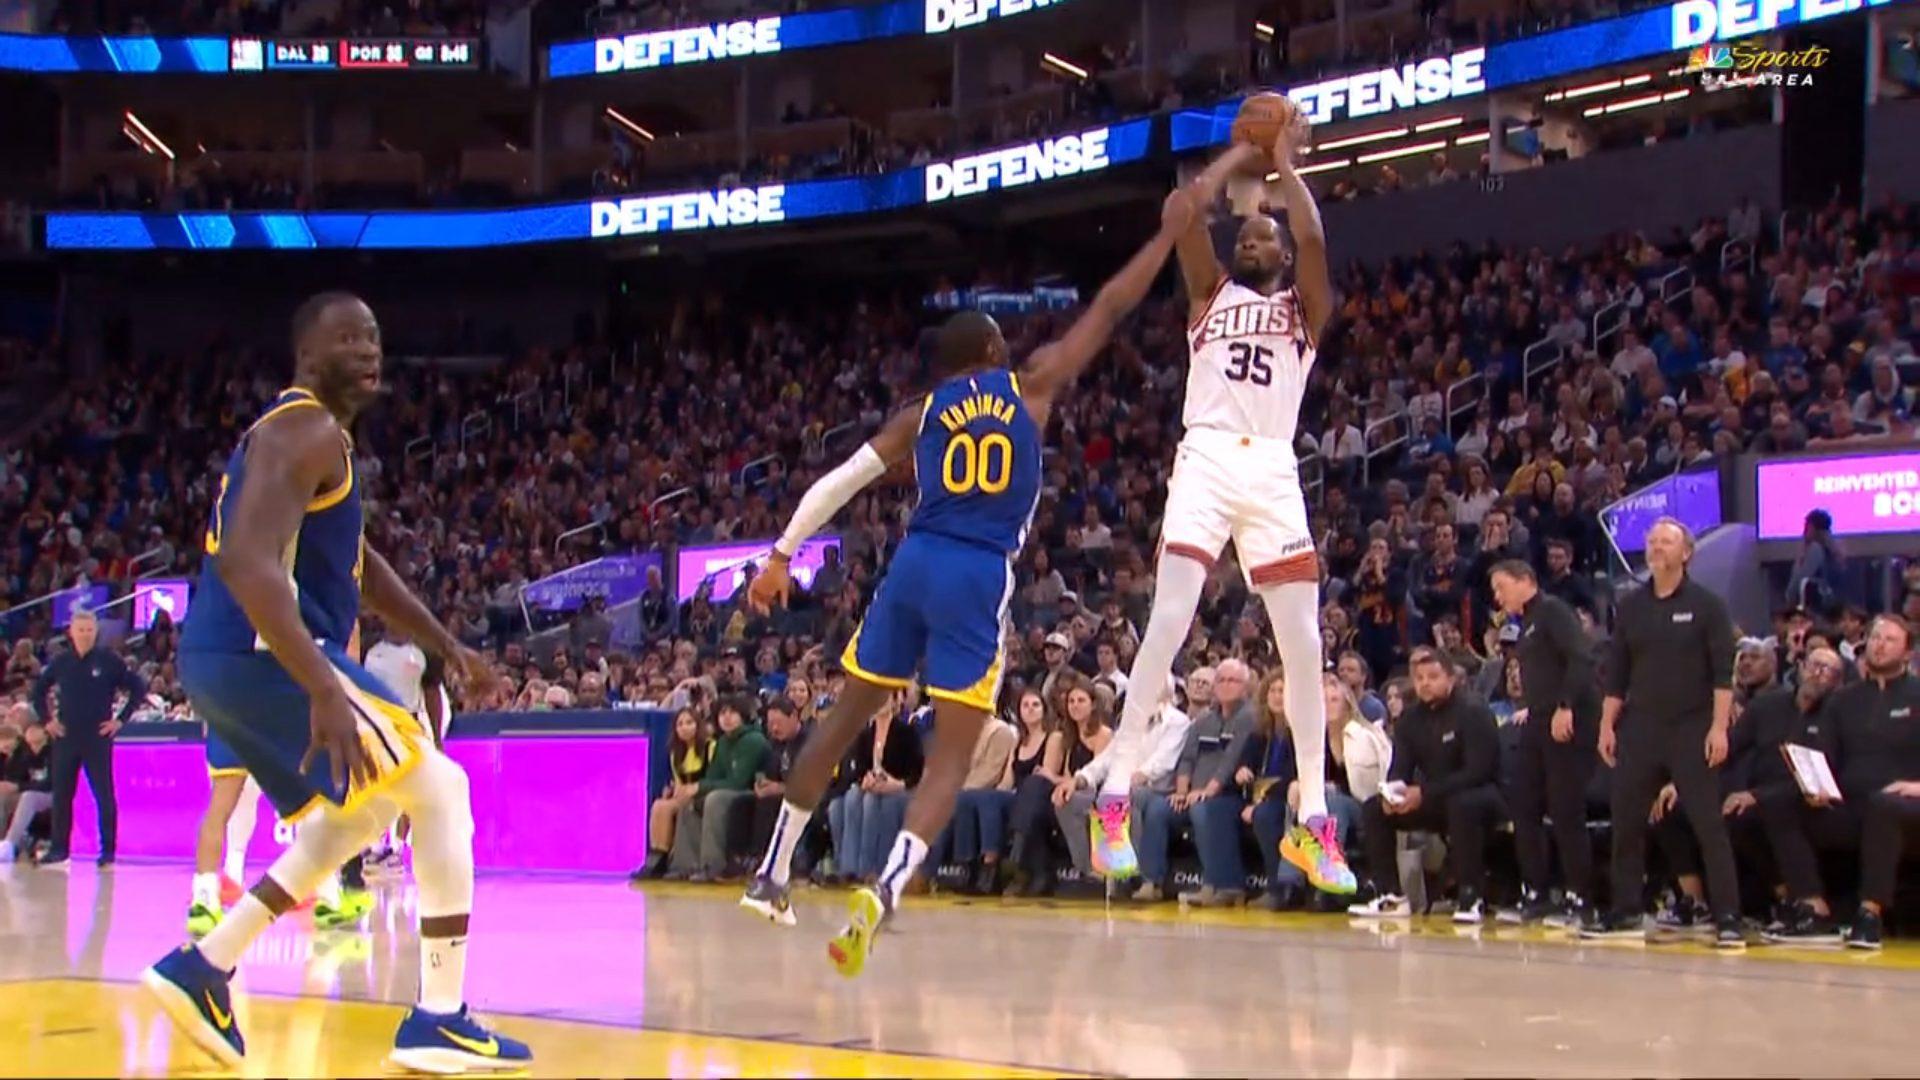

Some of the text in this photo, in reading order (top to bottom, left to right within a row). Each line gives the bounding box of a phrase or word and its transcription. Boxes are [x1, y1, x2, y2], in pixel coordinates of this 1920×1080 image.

[595, 16, 781, 73] DEFENSE
[1288, 47, 1486, 125] EFENSE
[926, 127, 1109, 202] DEFENSE
[591, 185, 785, 237] DEFENSE
[1205, 303, 1291, 342] SUNS
[1225, 342, 1274, 387] 35
[939, 393, 1016, 432] KUMINGA
[943, 432, 1012, 494] 00
